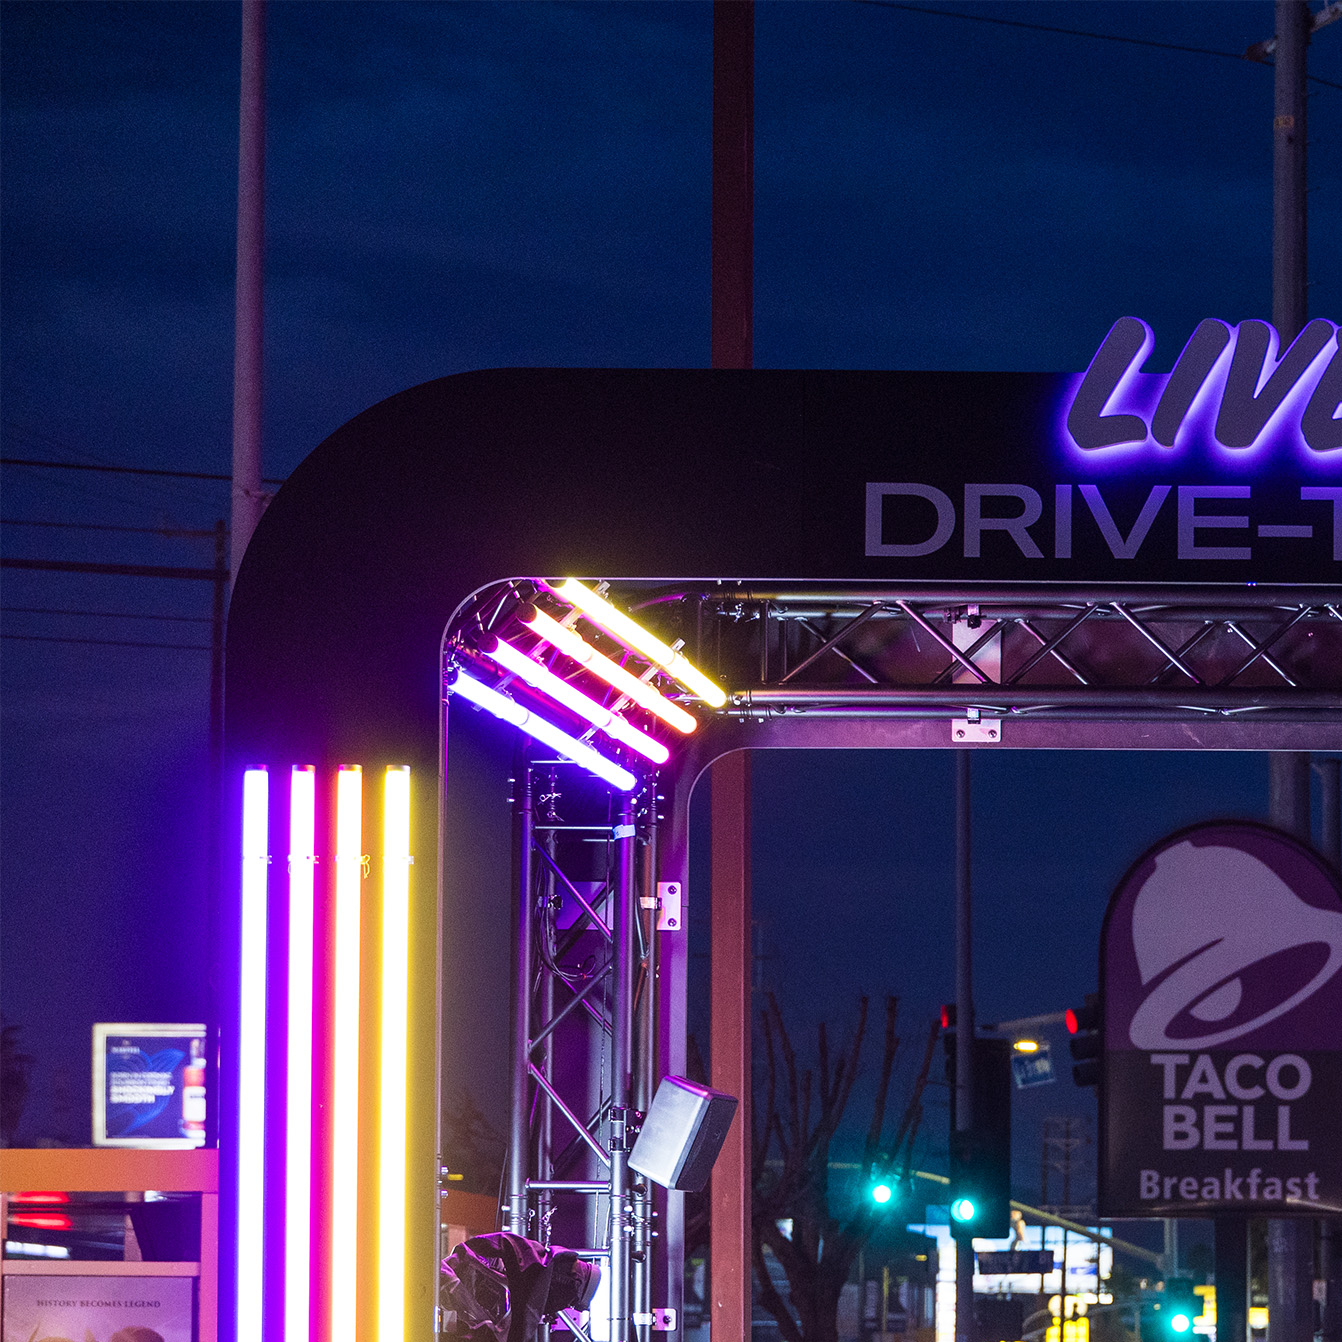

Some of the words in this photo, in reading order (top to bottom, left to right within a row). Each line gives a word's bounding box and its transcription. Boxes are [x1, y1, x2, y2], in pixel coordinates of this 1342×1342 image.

[1150, 1053, 1312, 1100] TACO
[1163, 1105, 1309, 1150] BELL
[1140, 1168, 1319, 1200] Breakfast
[80, 1300, 121, 1308] BECOMES
[124, 1300, 161, 1308] LEGEND
